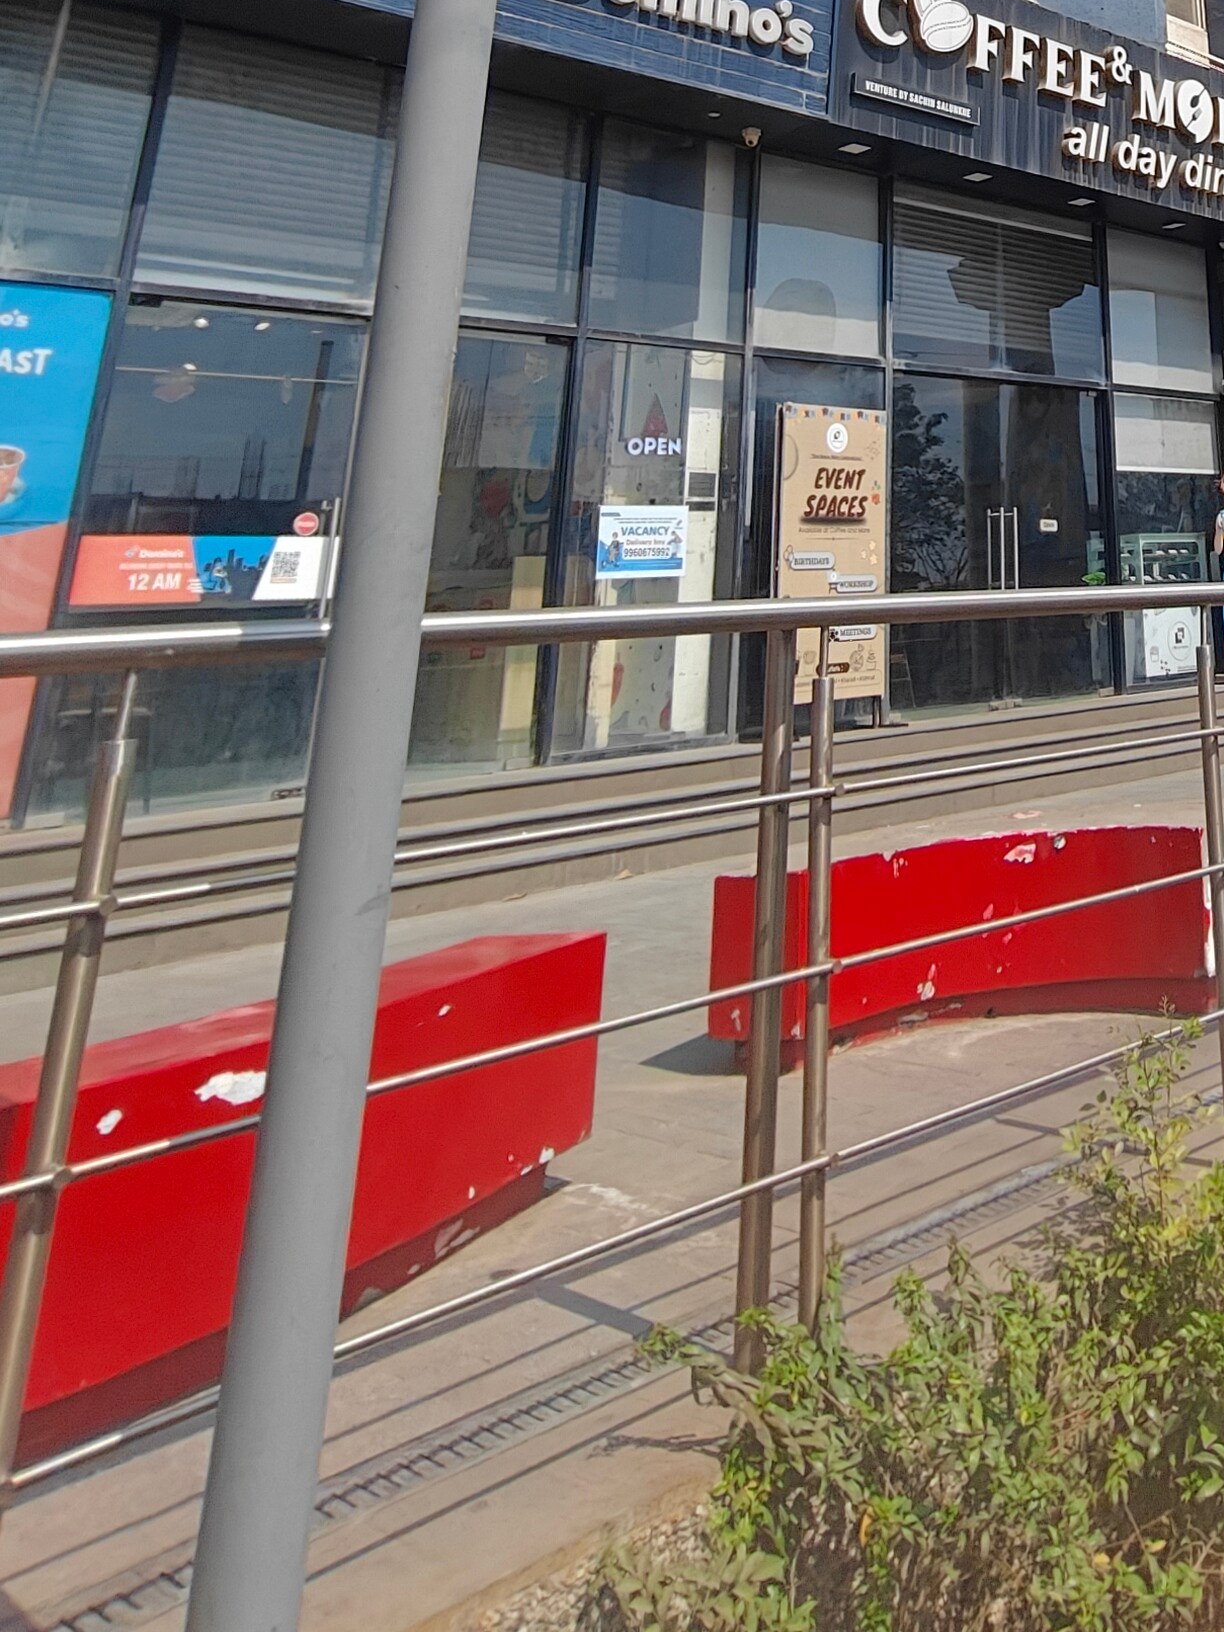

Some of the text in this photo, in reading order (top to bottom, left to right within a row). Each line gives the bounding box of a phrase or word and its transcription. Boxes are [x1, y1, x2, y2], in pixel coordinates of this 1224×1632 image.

[1105, 45, 1133, 86] &
[865, 79, 898, 99] VENTURE
[898, 89, 908, 102] BY
[1063, 121, 1109, 165] all
[1114, 134, 1178, 189] day
[626, 436, 683, 456] OPEN
[814, 466, 867, 490] EVENT
[803, 494, 869, 518] SPACES
[620, 525, 671, 537] VACANCY
[793, 557, 830, 566] BIRTHDAYS
[127, 572, 182, 591] 12 AM
[839, 627, 872, 637] MEETINGS
